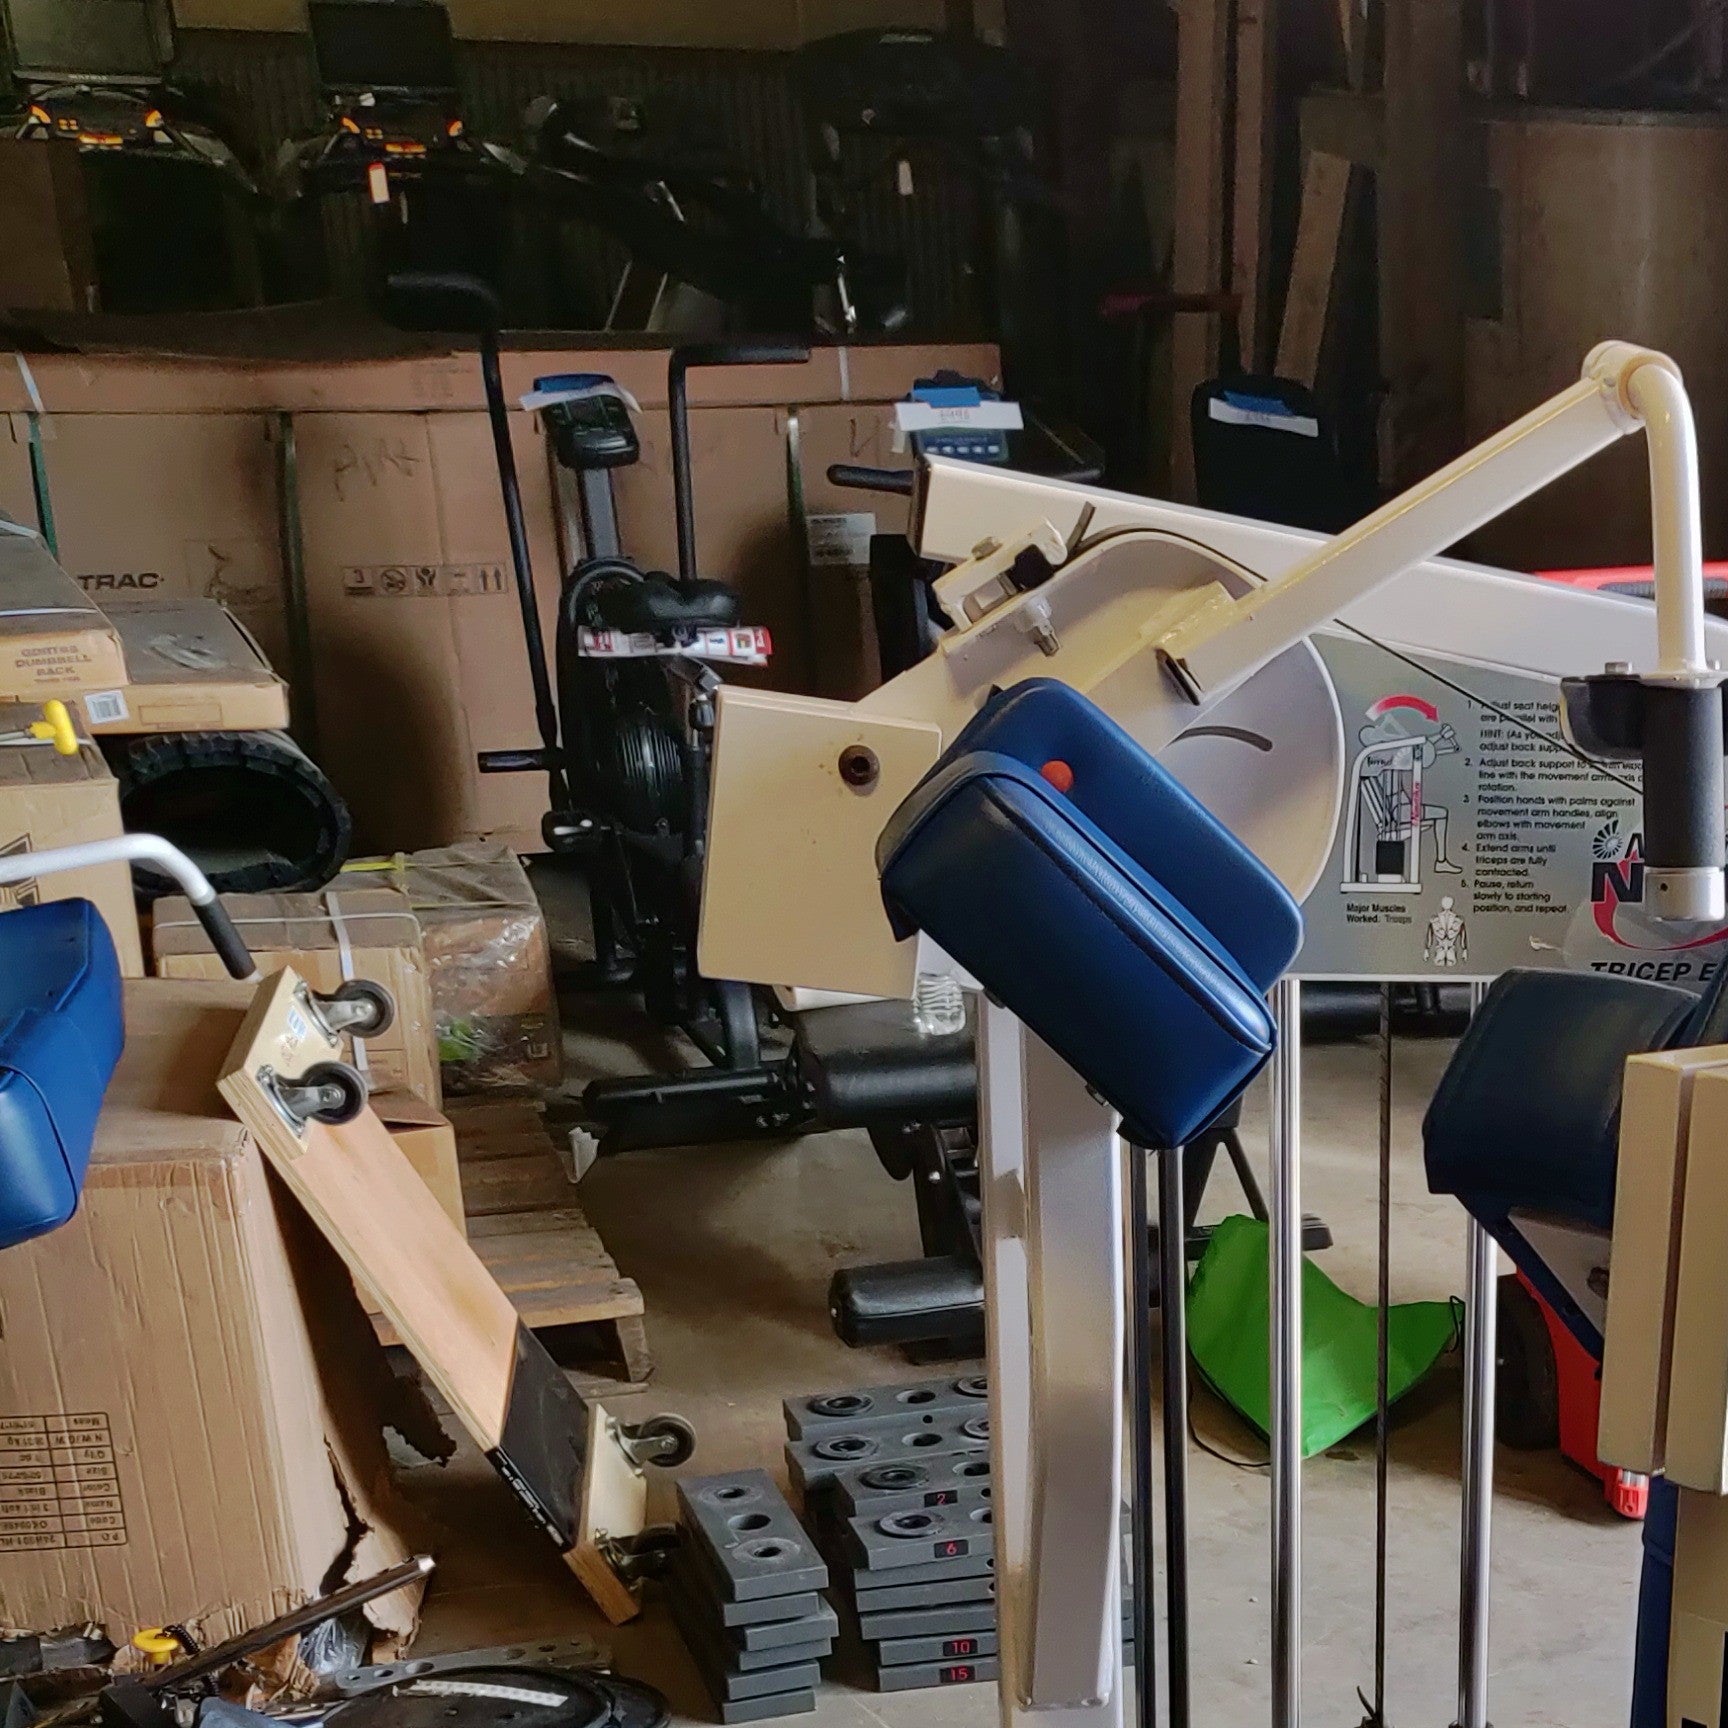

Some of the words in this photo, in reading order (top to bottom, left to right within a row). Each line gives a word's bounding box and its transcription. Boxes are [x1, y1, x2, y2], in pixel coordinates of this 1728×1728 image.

[77, 572, 160, 590] TRAC
[1538, 714, 1558, 722] with
[1479, 743, 1508, 752] adjust
[1511, 743, 1536, 751] back
[1479, 759, 1508, 769] Adjust
[1511, 759, 1535, 767] back
[1539, 760, 1574, 770] support
[1479, 772, 1495, 780] line
[1499, 772, 1518, 780] with
[1520, 772, 1535, 780] the
[1479, 783, 1517, 791] rotation.
[1478, 795, 1513, 804] Position
[1516, 796, 1545, 804] hands
[1569, 797, 1598, 807] palms
[1600, 798, 1635, 807] against
[1477, 808, 1528, 817] movement
[1531, 809, 1550, 817] arm
[1594, 810, 1618, 820] align
[1477, 820, 1510, 829] elbows
[1513, 821, 1532, 829] with
[1535, 821, 1585, 830] movement
[1476, 844, 1508, 852] Extend
[1511, 844, 1534, 852] arms
[1536, 844, 1556, 852] until
[1476, 857, 1508, 866] triceps
[1528, 856, 1548, 866] fully
[1473, 892, 1501, 902] slowly
[1516, 892, 1550, 903] starting
[1346, 904, 1369, 914] Major
[1372, 904, 1406, 913] Muscles
[1514, 904, 1533, 912] and
[937, 1493, 946, 1505] 2
[946, 1542, 957, 1555] 6
[953, 1641, 970, 1654] 10
[950, 1668, 967, 1681] 15
